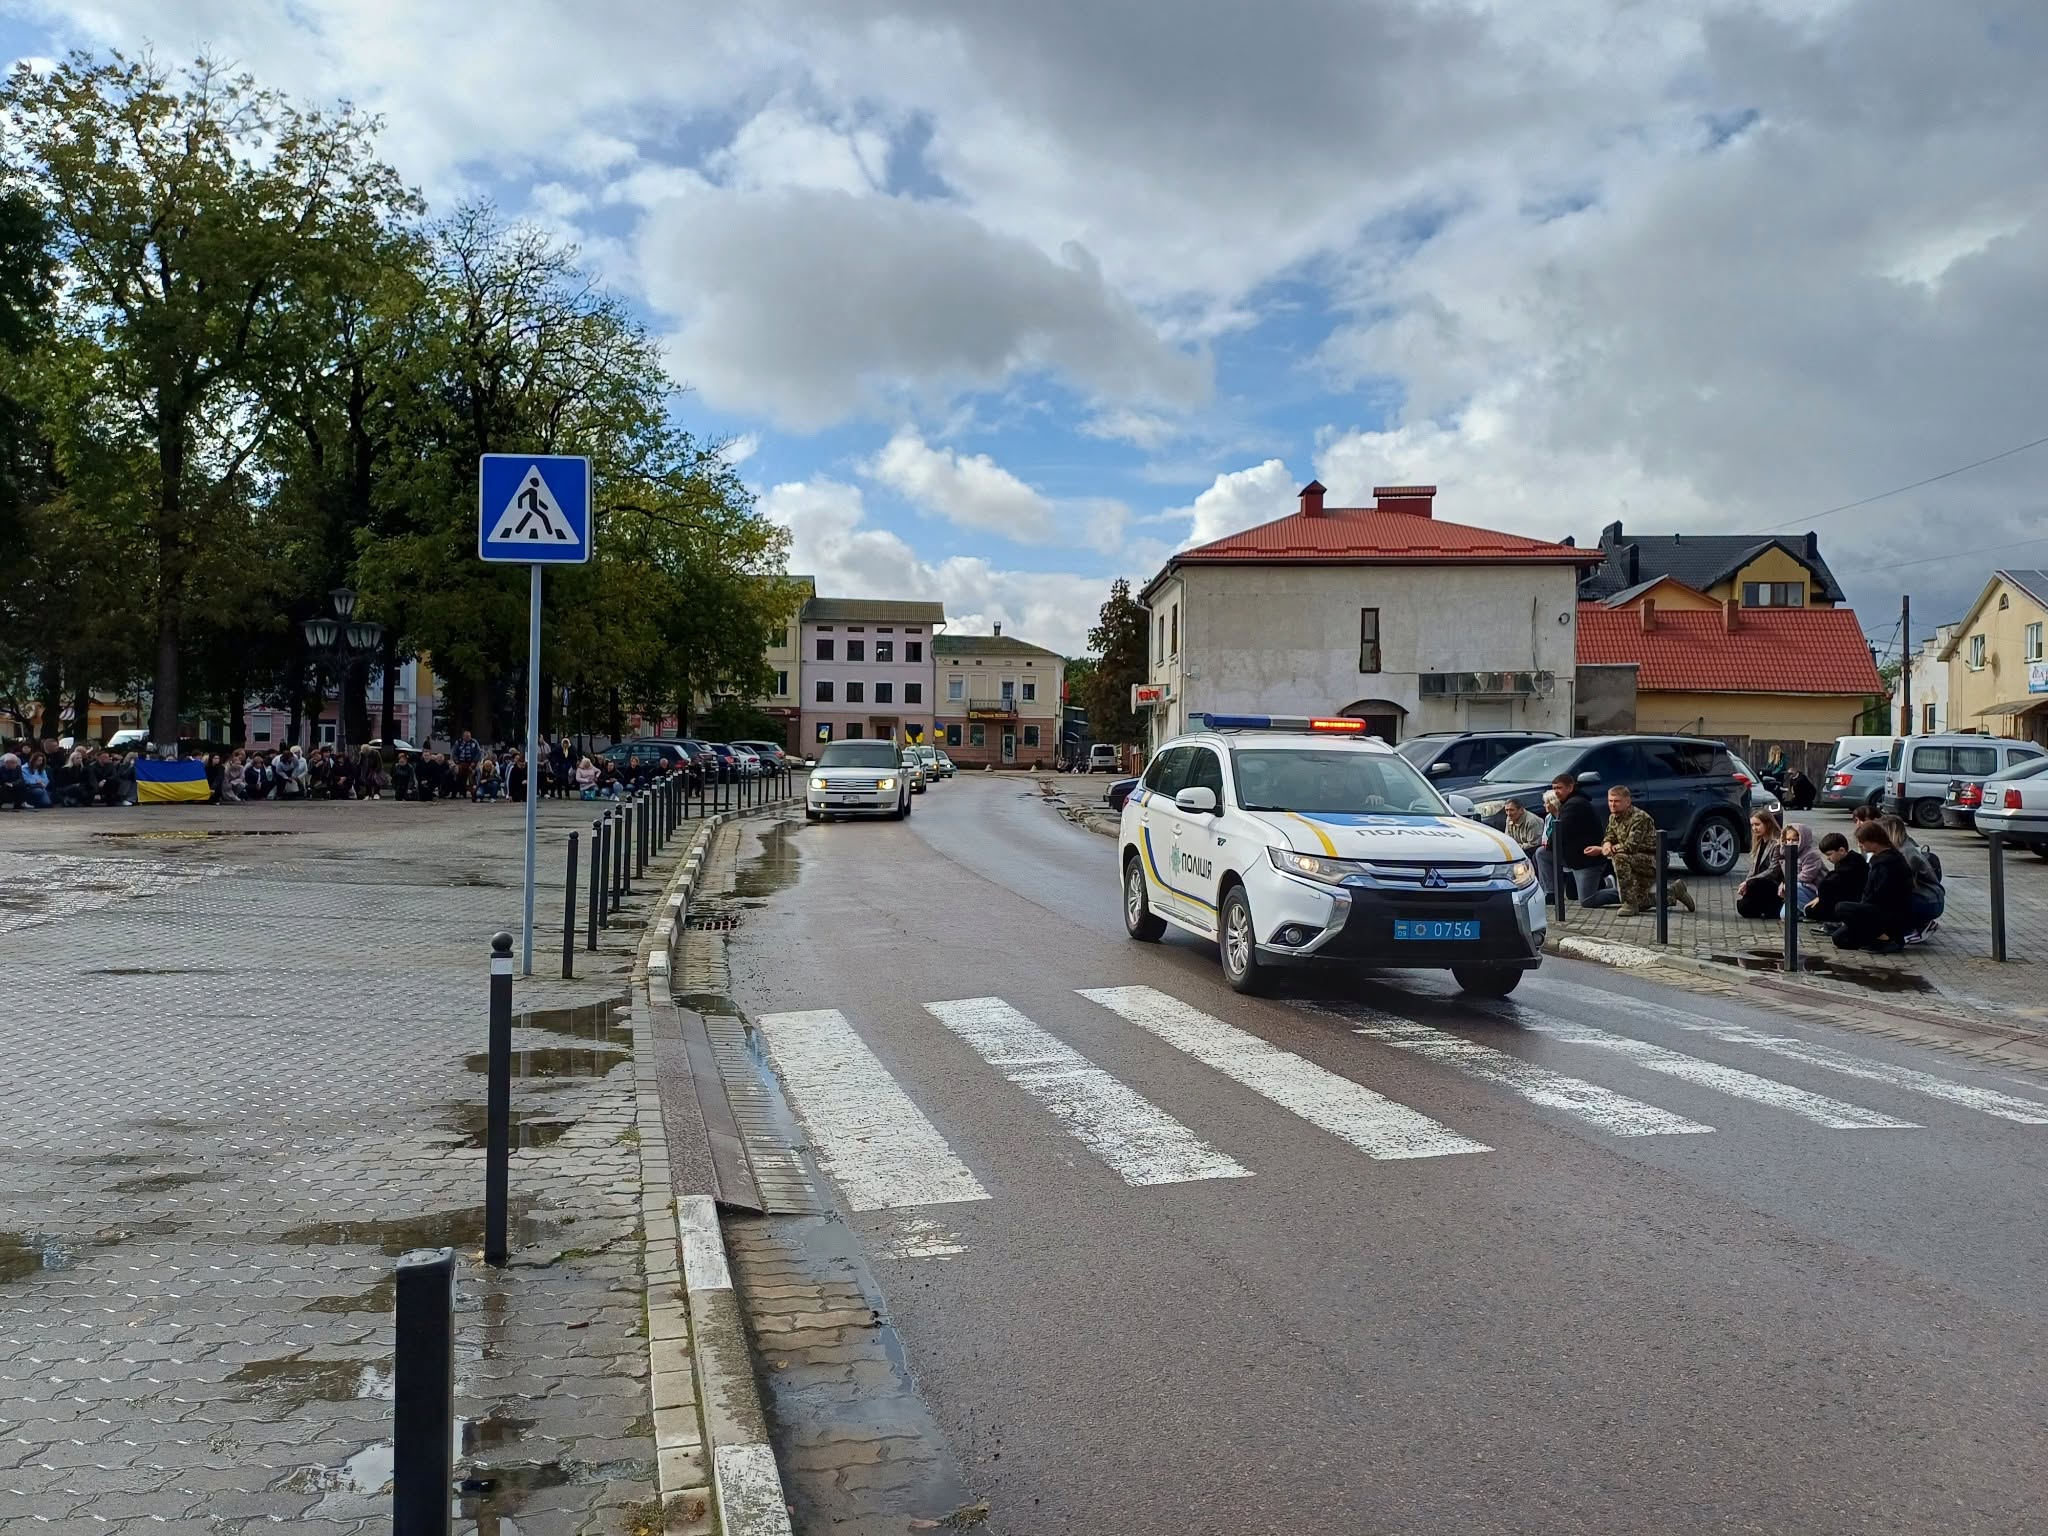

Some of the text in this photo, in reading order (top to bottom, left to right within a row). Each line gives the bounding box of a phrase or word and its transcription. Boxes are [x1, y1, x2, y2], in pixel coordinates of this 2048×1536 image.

[1355, 829, 1465, 839] ПОЛІЦІЯ
[1181, 852, 1212, 881] ПОЛІЦІЯ
[1397, 930, 1408, 938] 09
[1434, 922, 1472, 938] 0756
